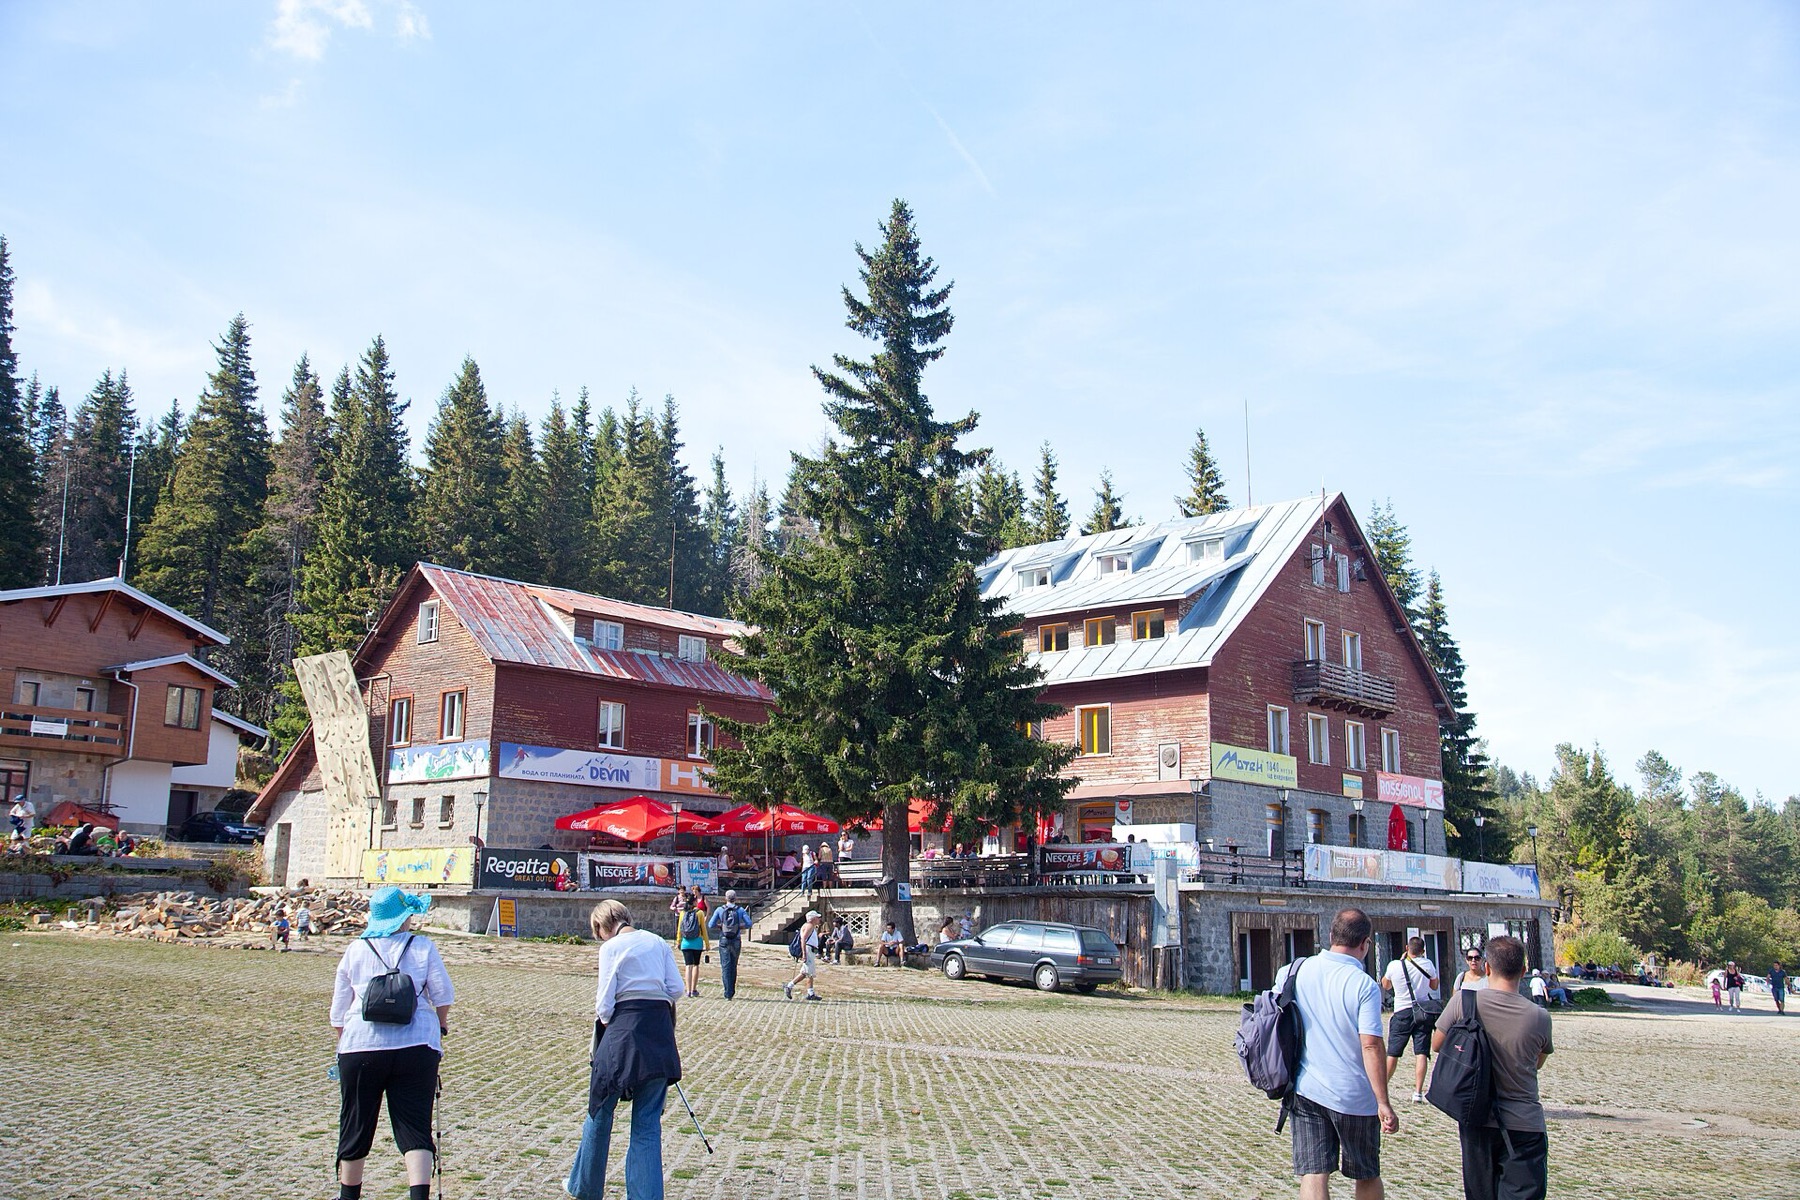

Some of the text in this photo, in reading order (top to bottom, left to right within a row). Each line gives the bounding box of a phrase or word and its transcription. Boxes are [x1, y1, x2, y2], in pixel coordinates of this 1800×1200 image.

[550, 772, 585, 780] ПЛАНИНАТА
[590, 766, 630, 782] DEVIN
[1380, 780, 1424, 799] ROSSIGNOL
[1046, 852, 1080, 863] NESCAFÉ
[485, 856, 550, 878] Regatta
[595, 866, 633, 878] NESCAFÉ
